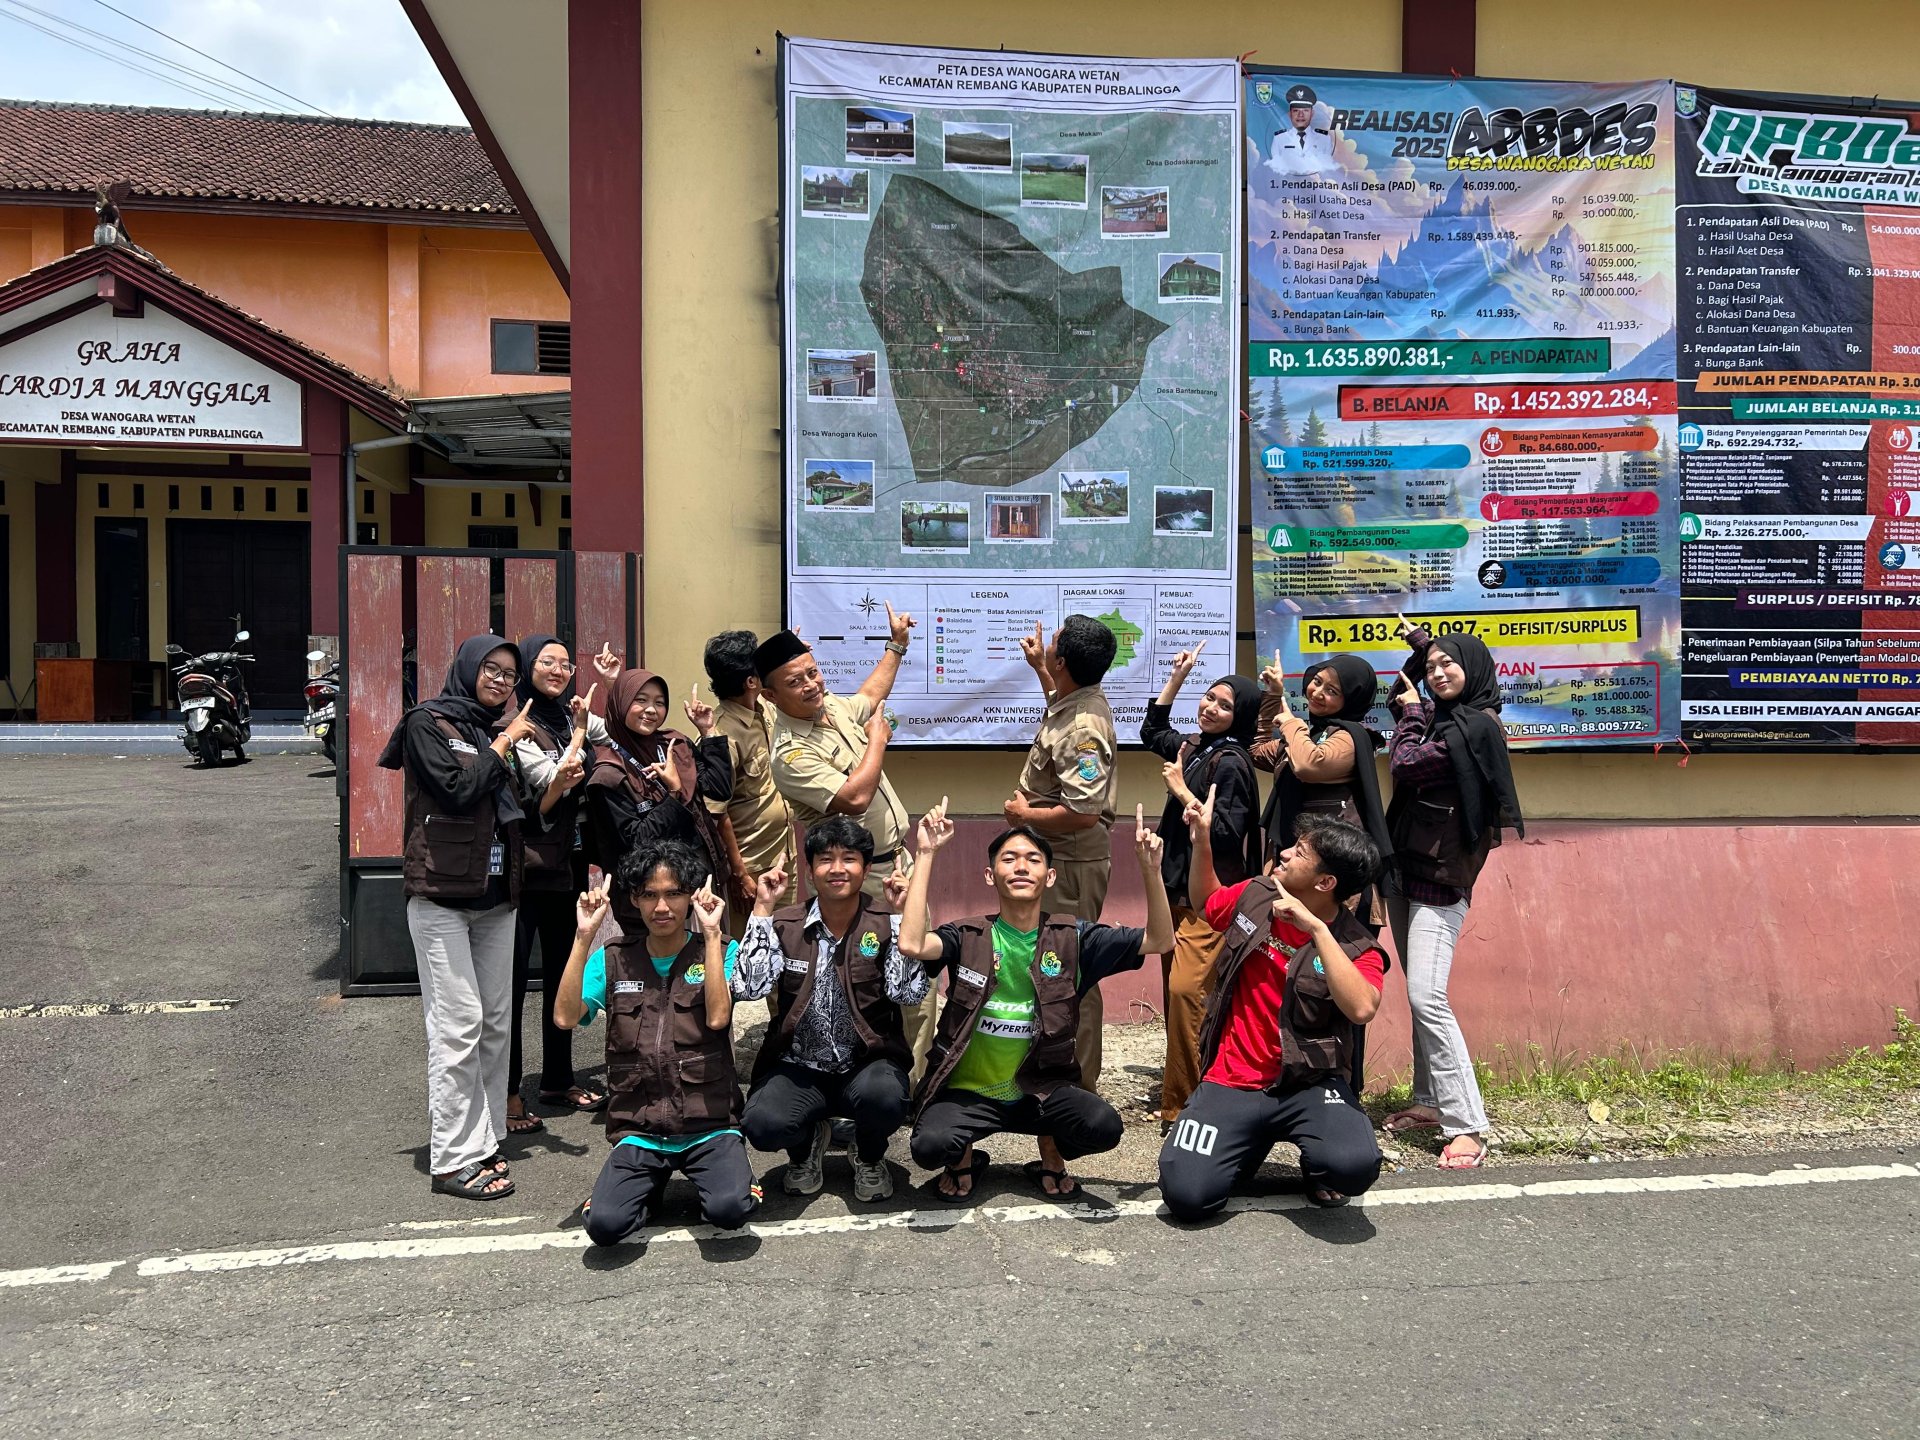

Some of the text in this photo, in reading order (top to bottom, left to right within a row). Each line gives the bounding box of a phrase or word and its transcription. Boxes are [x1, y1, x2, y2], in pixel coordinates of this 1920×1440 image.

[937, 64, 1120, 81] PETA DESA WANOGARA WETAN
[879, 75, 1180, 96] KECAMATAN REMBANG KABUPATEN PURBALINGGA
[1330, 109, 1453, 134] REALISASI
[1448, 102, 1658, 159] APBDES
[1392, 138, 1446, 158] 2025
[1447, 154, 1654, 172] DESA WANOGARA WETAN
[1701, 157, 1907, 186] tahun anggaran
[1270, 180, 1521, 194] 1. Pendapatan Asli Desa (PAD) Rp. 46.039.000,-
[1749, 178, 1898, 201] DESA WANOGARA
[1282, 193, 1639, 207] a. Hasil Usaha Desa Rp. 16.039.000,-
[1687, 217, 1856, 232] 1. Pendapatan Asli Desa (PAD) Rp.
[1270, 231, 1522, 244] 2. Pendapatan Transfer Rp. 1.589.439.448,-
[1272, 308, 1521, 322] 3. Pendapatan Lain-lain Rp. 411.933,-
[77, 340, 181, 365] GRAHA
[1269, 348, 1598, 370] Rp. 1.635.890.381,- A. PENDAPATAN
[1713, 376, 1899, 388] JUMLAH PENDAPATAN Rp.
[115, 379, 270, 407] MANGGALA
[1353, 390, 1658, 413] B. BELANJA Rp. 1.452.392.284,-
[1746, 404, 1900, 416] JUMLAH BELANJA Rp.
[61, 411, 195, 424] DESA WANOGARA WETAN
[0, 423, 263, 439] ECAMATAN REMBANG KABUPATEN PURBALINGGA
[1582, 430, 1644, 439] Kemasyarakatan
[1519, 443, 1604, 452] Rp. 84.680.000,-
[1707, 439, 1802, 448] Rp. 692.294.732,-
[1303, 449, 1393, 459] Bidang Pemerintah Desa
[1303, 458, 1395, 471] Rp. 621.599.320,-
[1310, 529, 1334, 537] Bidang
[1310, 538, 1400, 548] Rp. 592.549.000,-
[1748, 595, 1905, 607] SURPLUS / DEFISIT Rp.
[1308, 618, 1627, 644] Rp. 183.48.097,- DEFISIT/SURPLUS
[1570, 676, 1653, 689] Rp. 85.511.675,-
[1740, 673, 1888, 683] PEMBIAYAAN NETTO
[984, 706, 1001, 714] KKN
[1689, 706, 1861, 716] SISA LEBIH PEMBIAYAAN
[934, 716, 983, 724] WANOGARA
[985, 716, 1016, 724] WETAN
[1523, 720, 1649, 736] SILPA Rp. 88.009.772,-
[981, 1018, 1034, 1034] MyPERTA
[1173, 1119, 1219, 1156] 100
